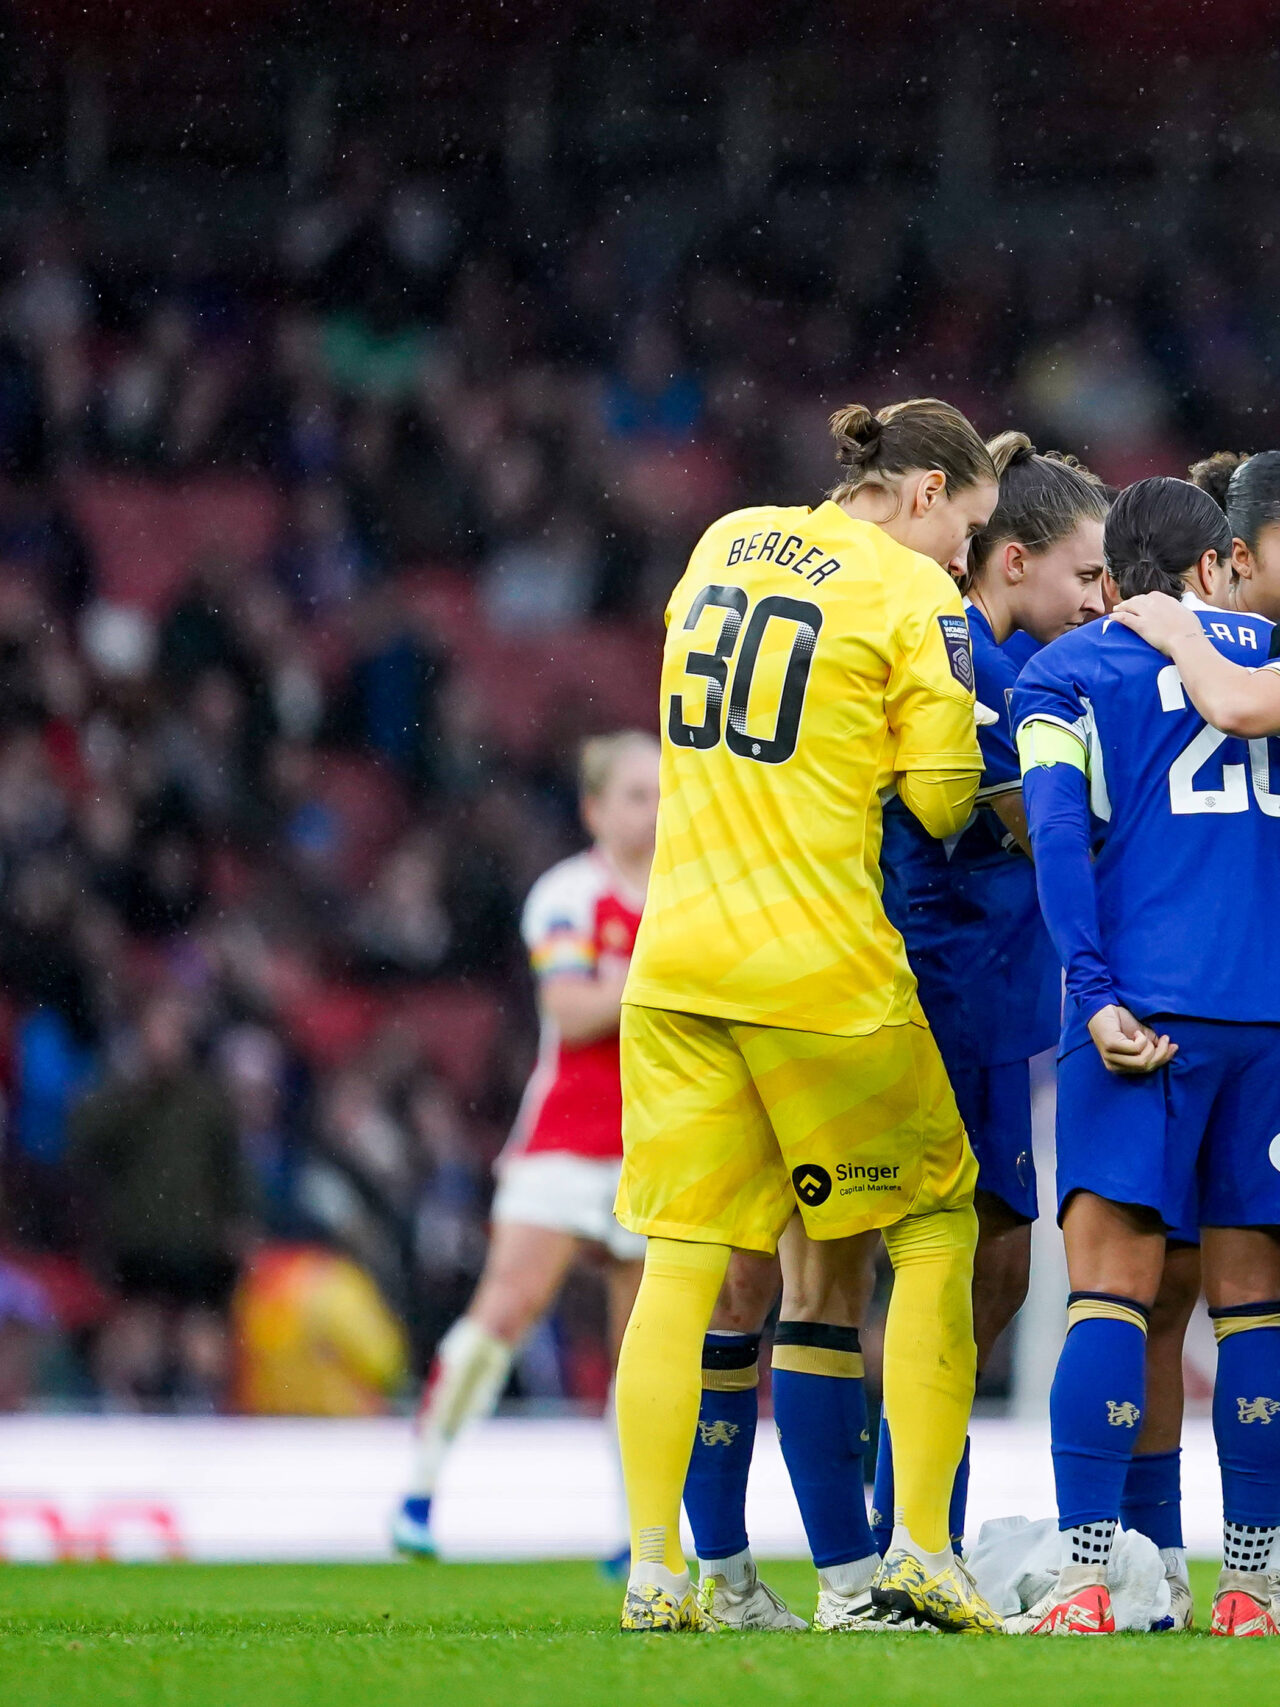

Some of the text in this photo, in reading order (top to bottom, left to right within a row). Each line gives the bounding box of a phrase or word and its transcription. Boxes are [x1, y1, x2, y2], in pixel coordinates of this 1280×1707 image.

[726, 531, 841, 586] BERGER
[667, 584, 824, 766] 30
[835, 1162, 900, 1182] Singer
[839, 1184, 865, 1197] Capital
